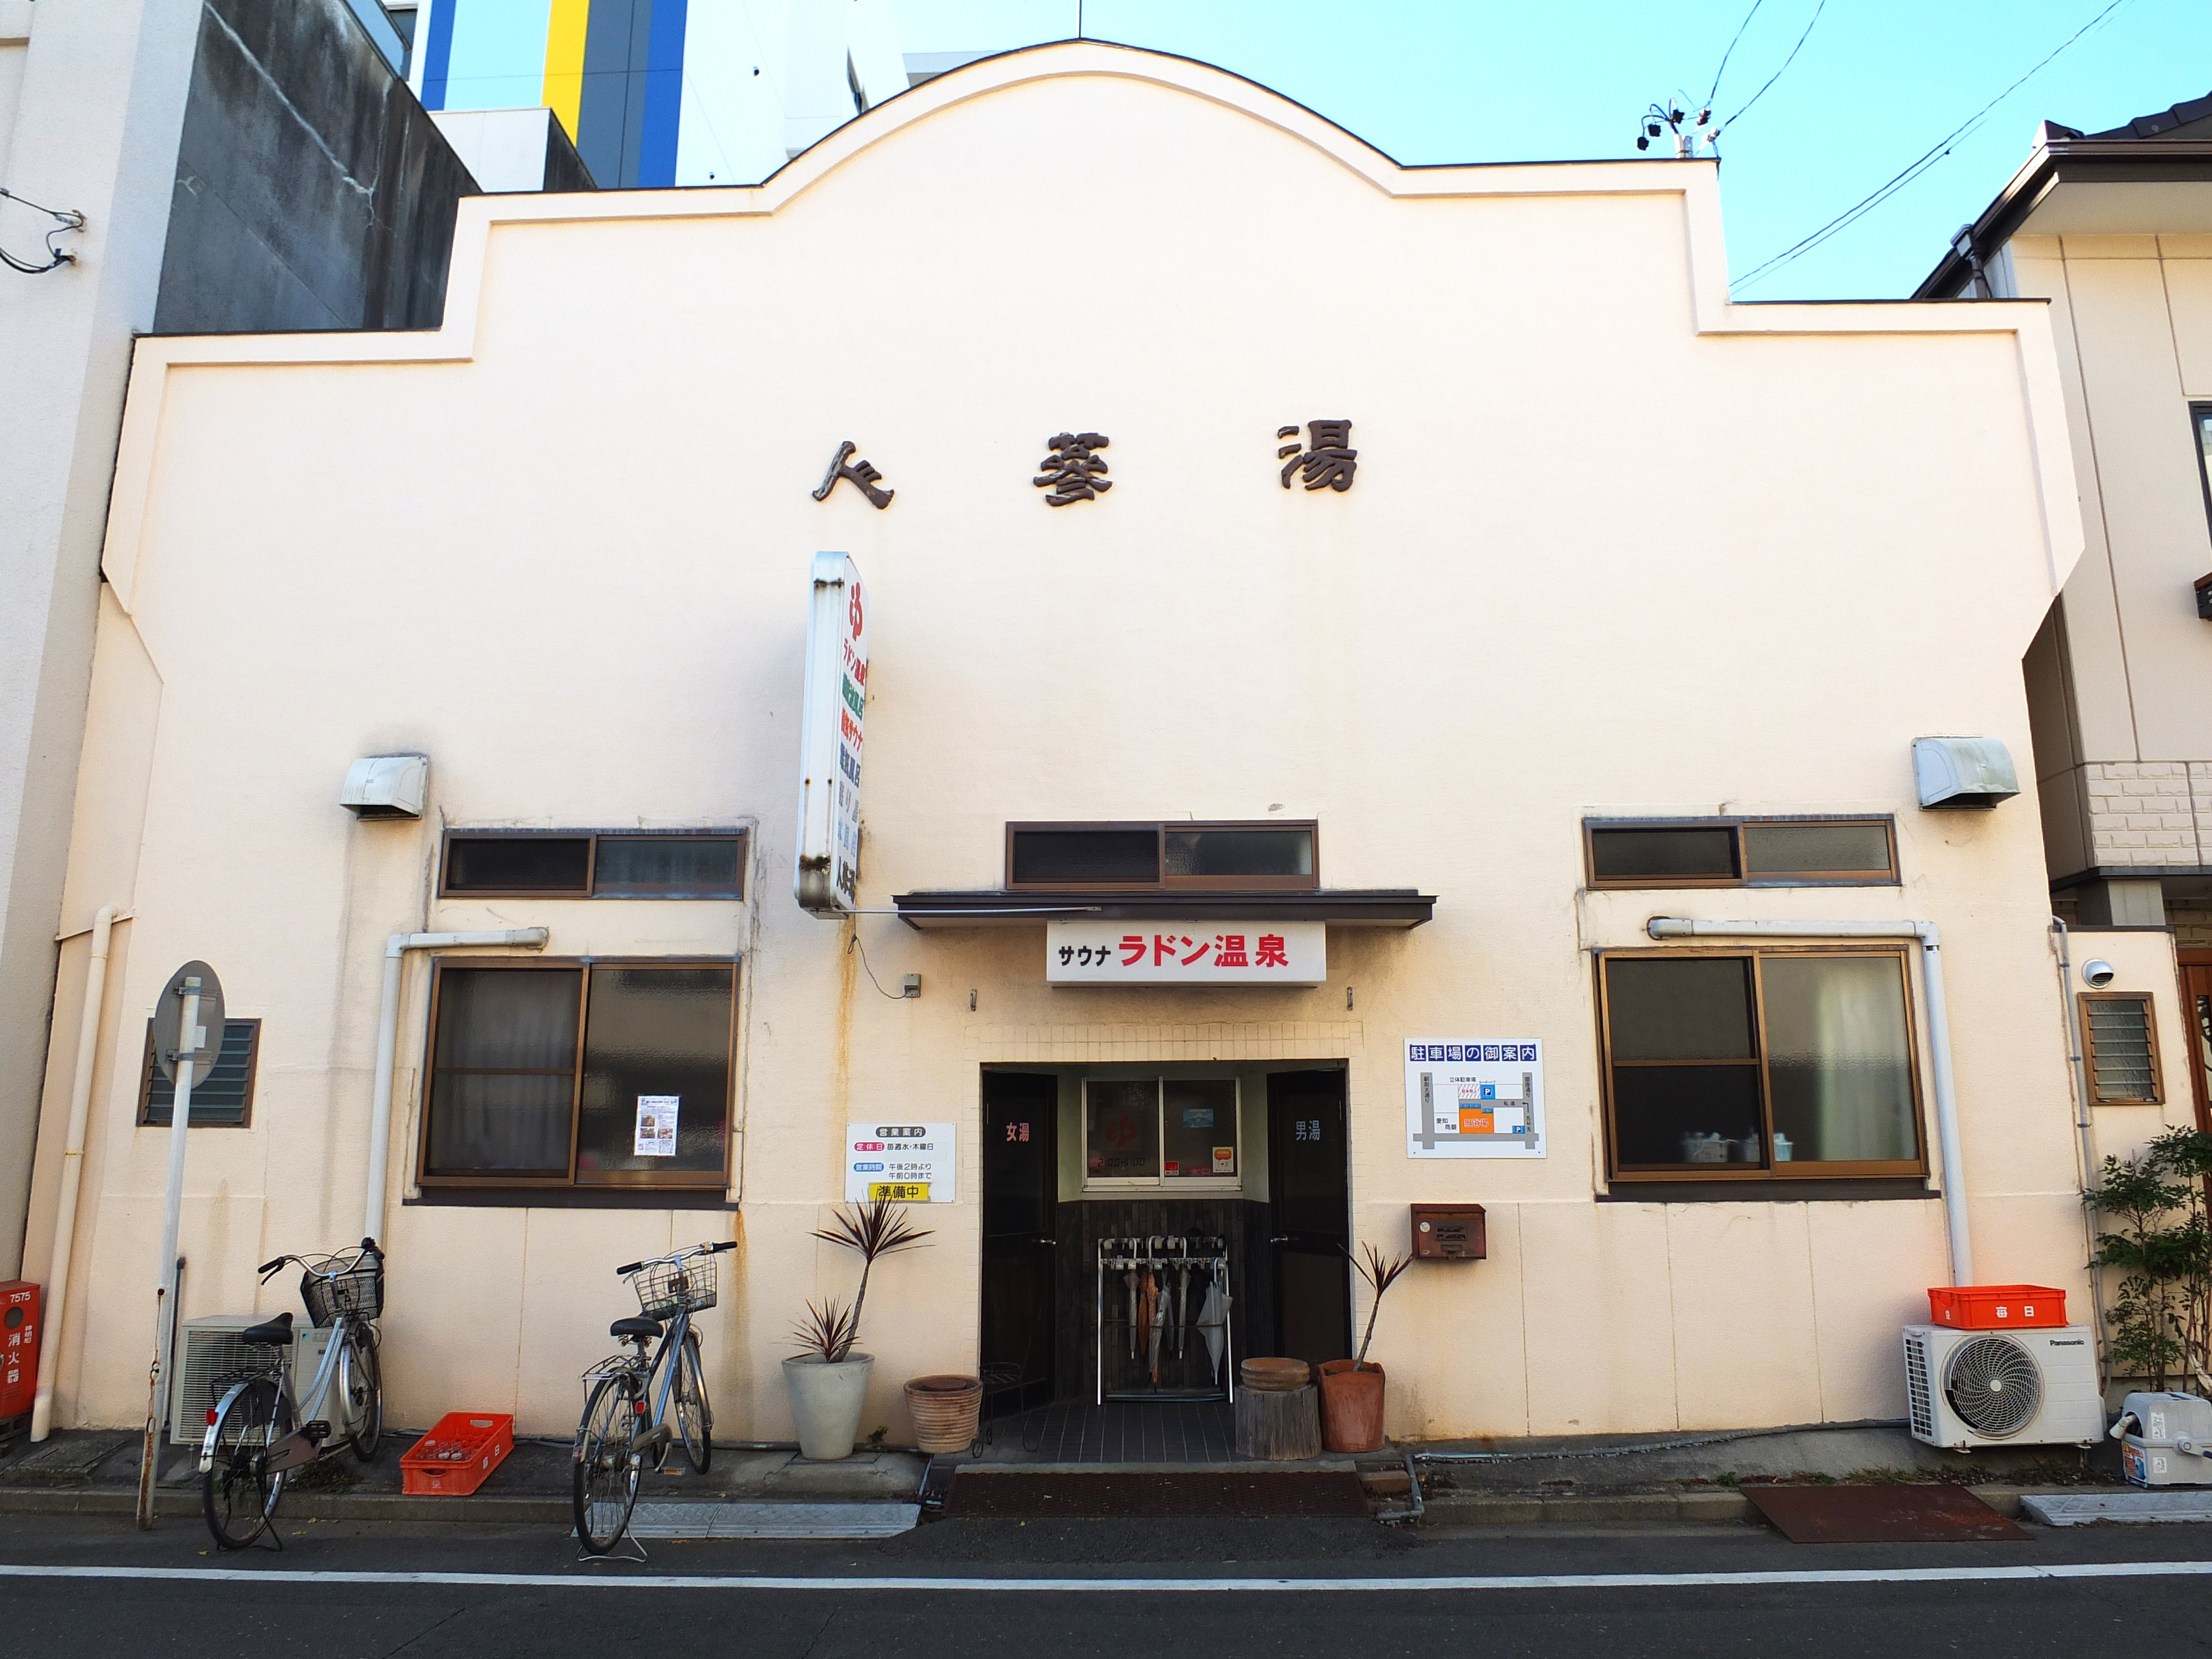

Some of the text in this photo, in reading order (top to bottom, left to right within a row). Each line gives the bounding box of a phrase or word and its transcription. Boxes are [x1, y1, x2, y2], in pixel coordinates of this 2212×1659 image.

[849, 582, 863, 642] ゆ
[1058, 933, 1290, 968] サウナ ラドン温泉
[1410, 1045, 1536, 1061] 駐車場の御案内
[879, 1128, 923, 1136] 営業案内
[1006, 1121, 1029, 1142] 女湯
[1296, 1120, 1320, 1140] 男湯
[878, 1185, 919, 1198] 準備中
[10, 1291, 31, 1303] 7575
[7, 1332, 22, 1384] 消火器
